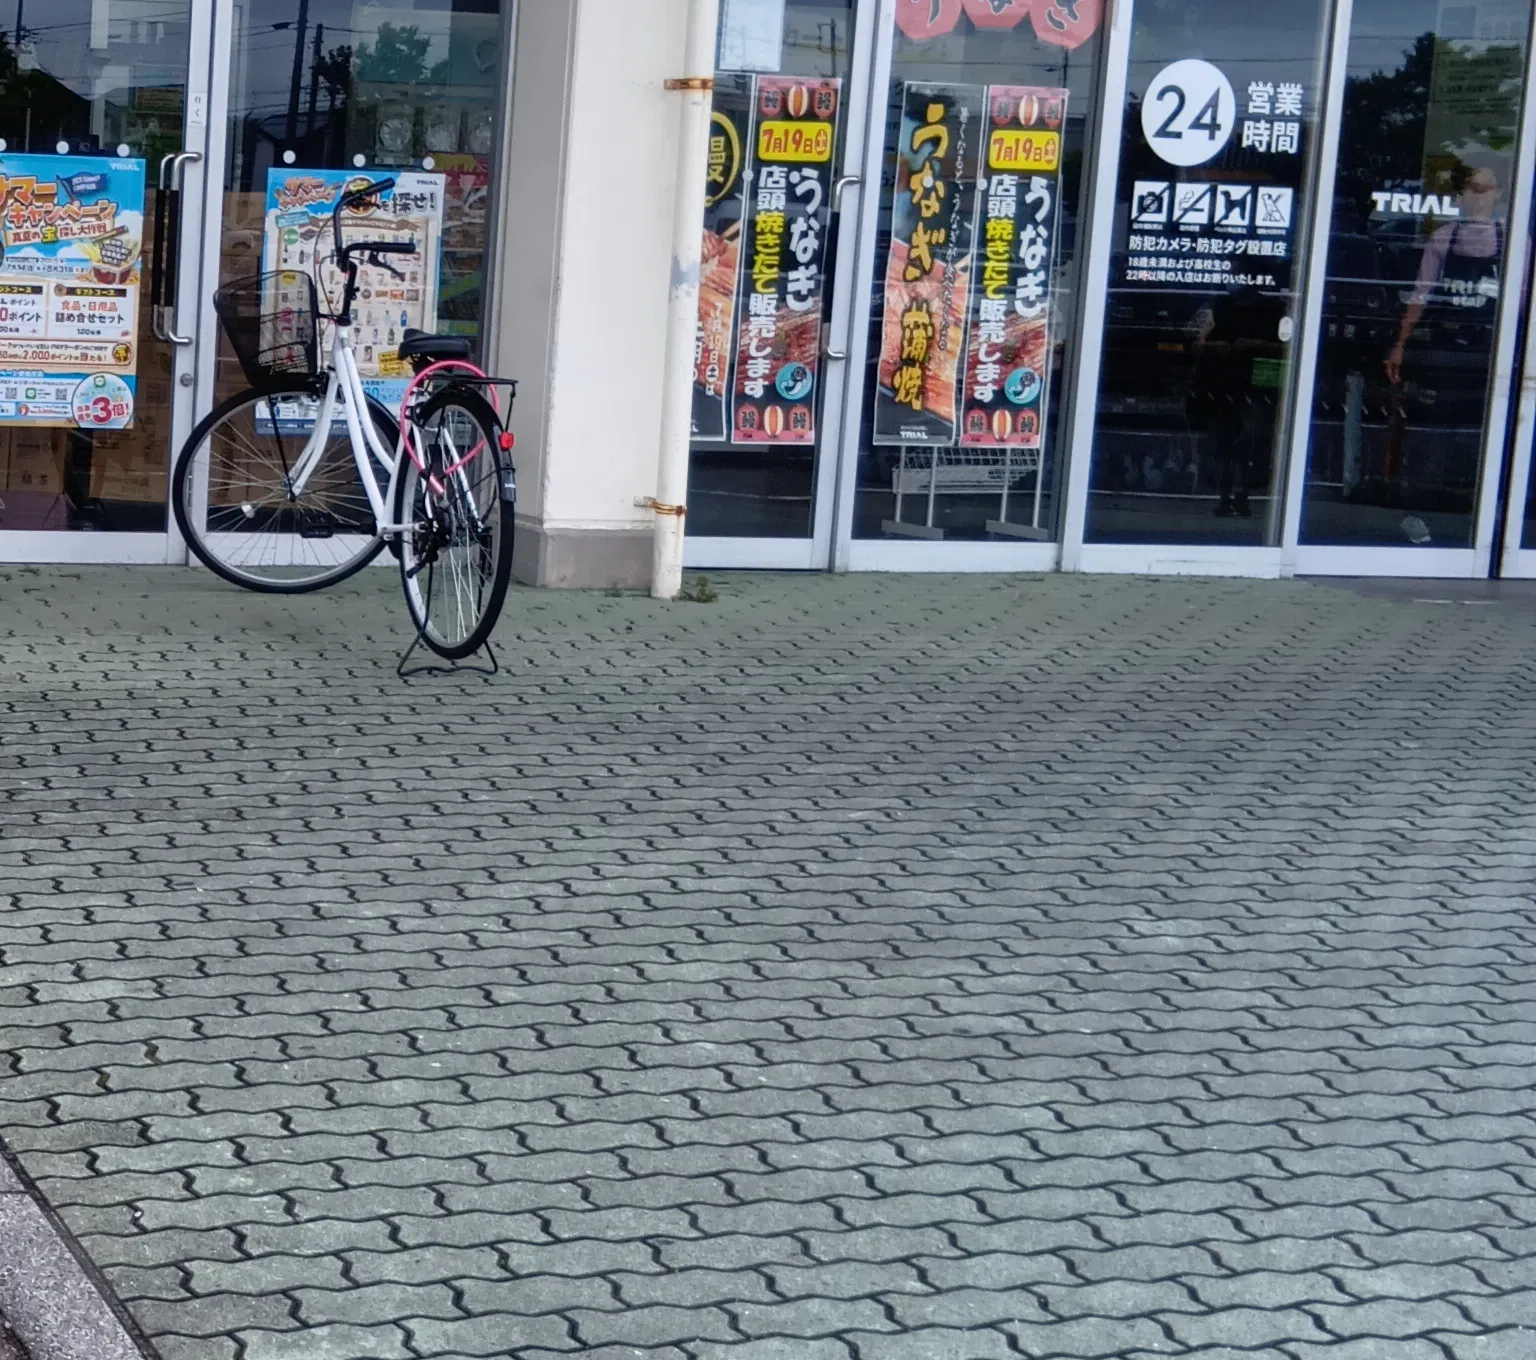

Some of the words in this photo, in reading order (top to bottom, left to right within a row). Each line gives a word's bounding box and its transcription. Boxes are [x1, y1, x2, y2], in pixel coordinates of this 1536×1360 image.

[1151, 84, 1222, 142] 24
[1247, 80, 1305, 117] 営業
[1240, 119, 1300, 155] 時間
[909, 103, 949, 282] うなぎ
[1371, 191, 1461, 216] TRIAL
[5, 199, 118, 227] キャンペーン
[785, 167, 823, 312] うなぎ
[1014, 175, 1051, 318] うなぎ
[1128, 235, 1288, 256] 防犯カメラ・防犯タグ設置店
[743, 165, 789, 399] 店頭焼きたて販売します
[972, 173, 1019, 404] 店頭焼きたて販売します
[10, 298, 36, 306] ポイント
[55, 312, 125, 324] 詰め合せセット
[60, 300, 119, 313] 食品・日用品
[900, 430, 929, 440] TRIAL
